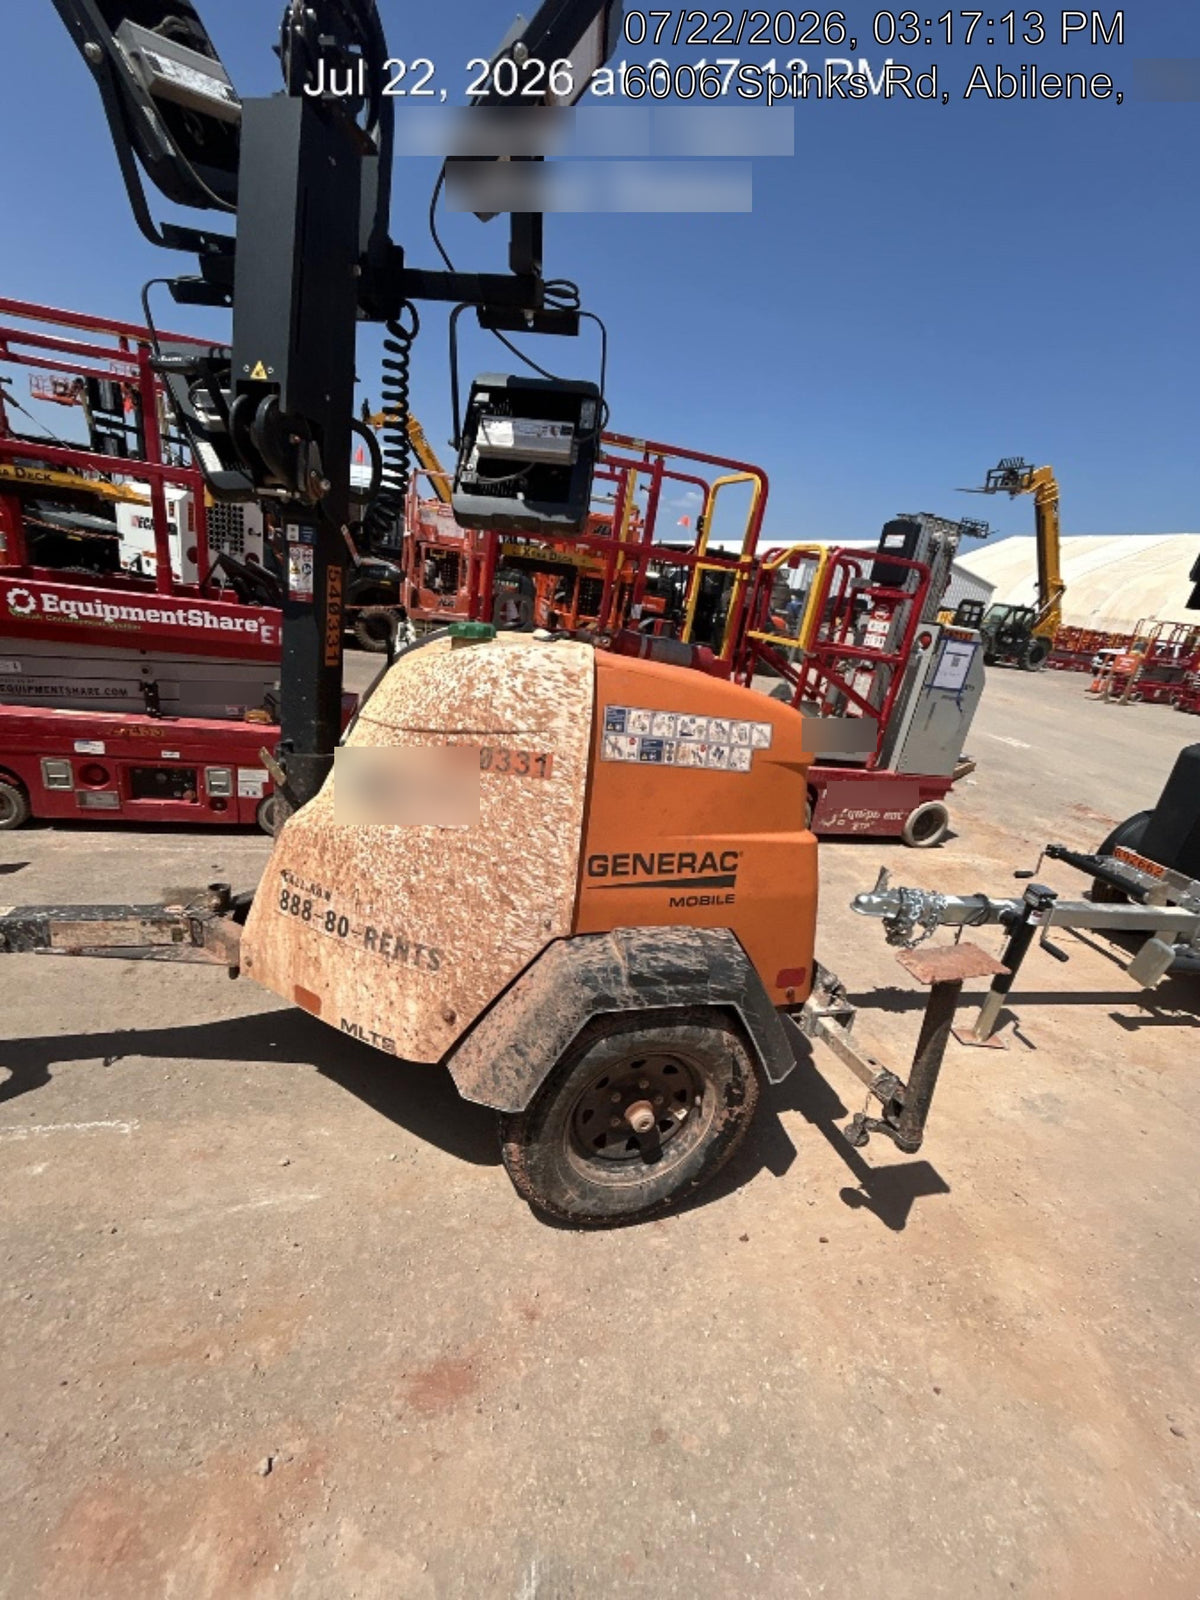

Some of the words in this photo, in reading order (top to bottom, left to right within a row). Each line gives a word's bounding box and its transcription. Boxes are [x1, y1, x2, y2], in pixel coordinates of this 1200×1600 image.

[327, 568, 341, 662] 540331
[480, 746, 547, 777] 0331
[588, 851, 739, 877] GENERAC
[669, 894, 736, 908] MOBILE
[280, 889, 441, 972] 888-80-RENTS
